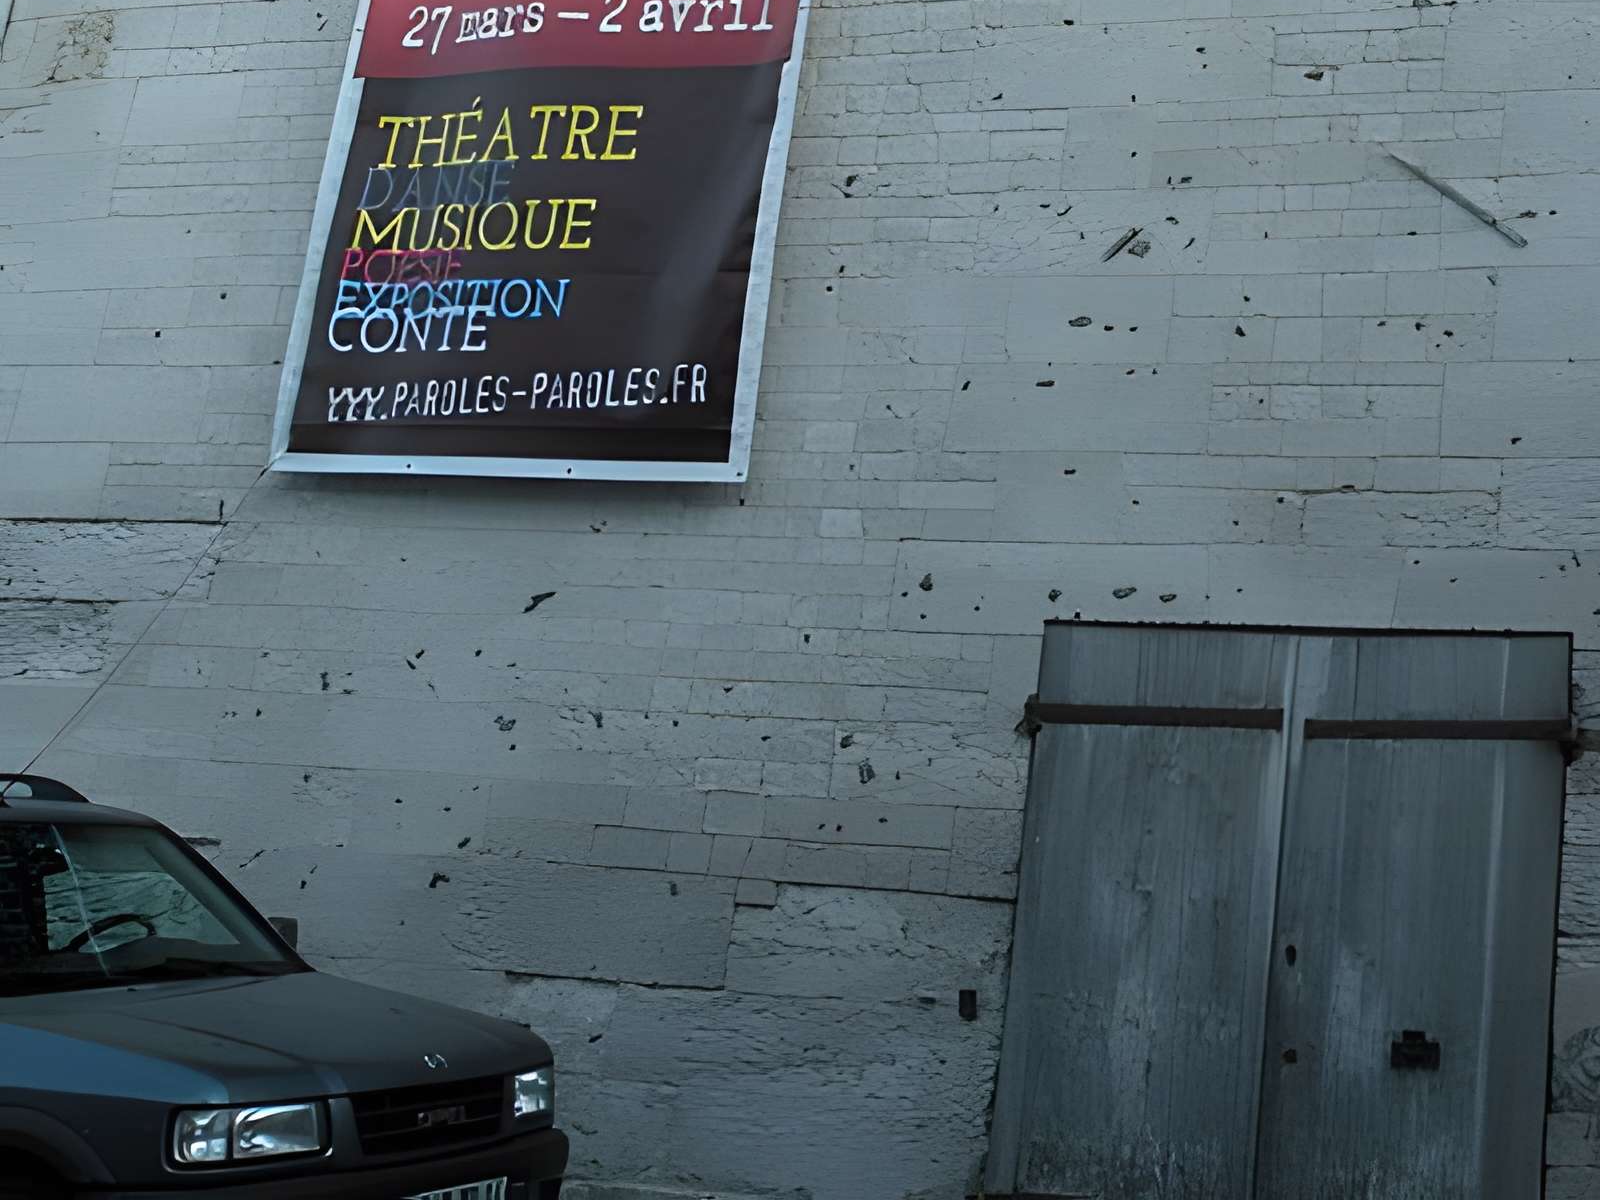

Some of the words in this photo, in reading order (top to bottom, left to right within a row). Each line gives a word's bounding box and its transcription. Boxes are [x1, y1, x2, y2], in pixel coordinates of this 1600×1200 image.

[402, 5, 452, 55] 27
[456, 2, 545, 43] mars
[356, 159, 516, 213] DANSE
[350, 199, 597, 252] MUSIQUE
[334, 278, 570, 320] EXPOSITION
[328, 306, 488, 352] CONTE
